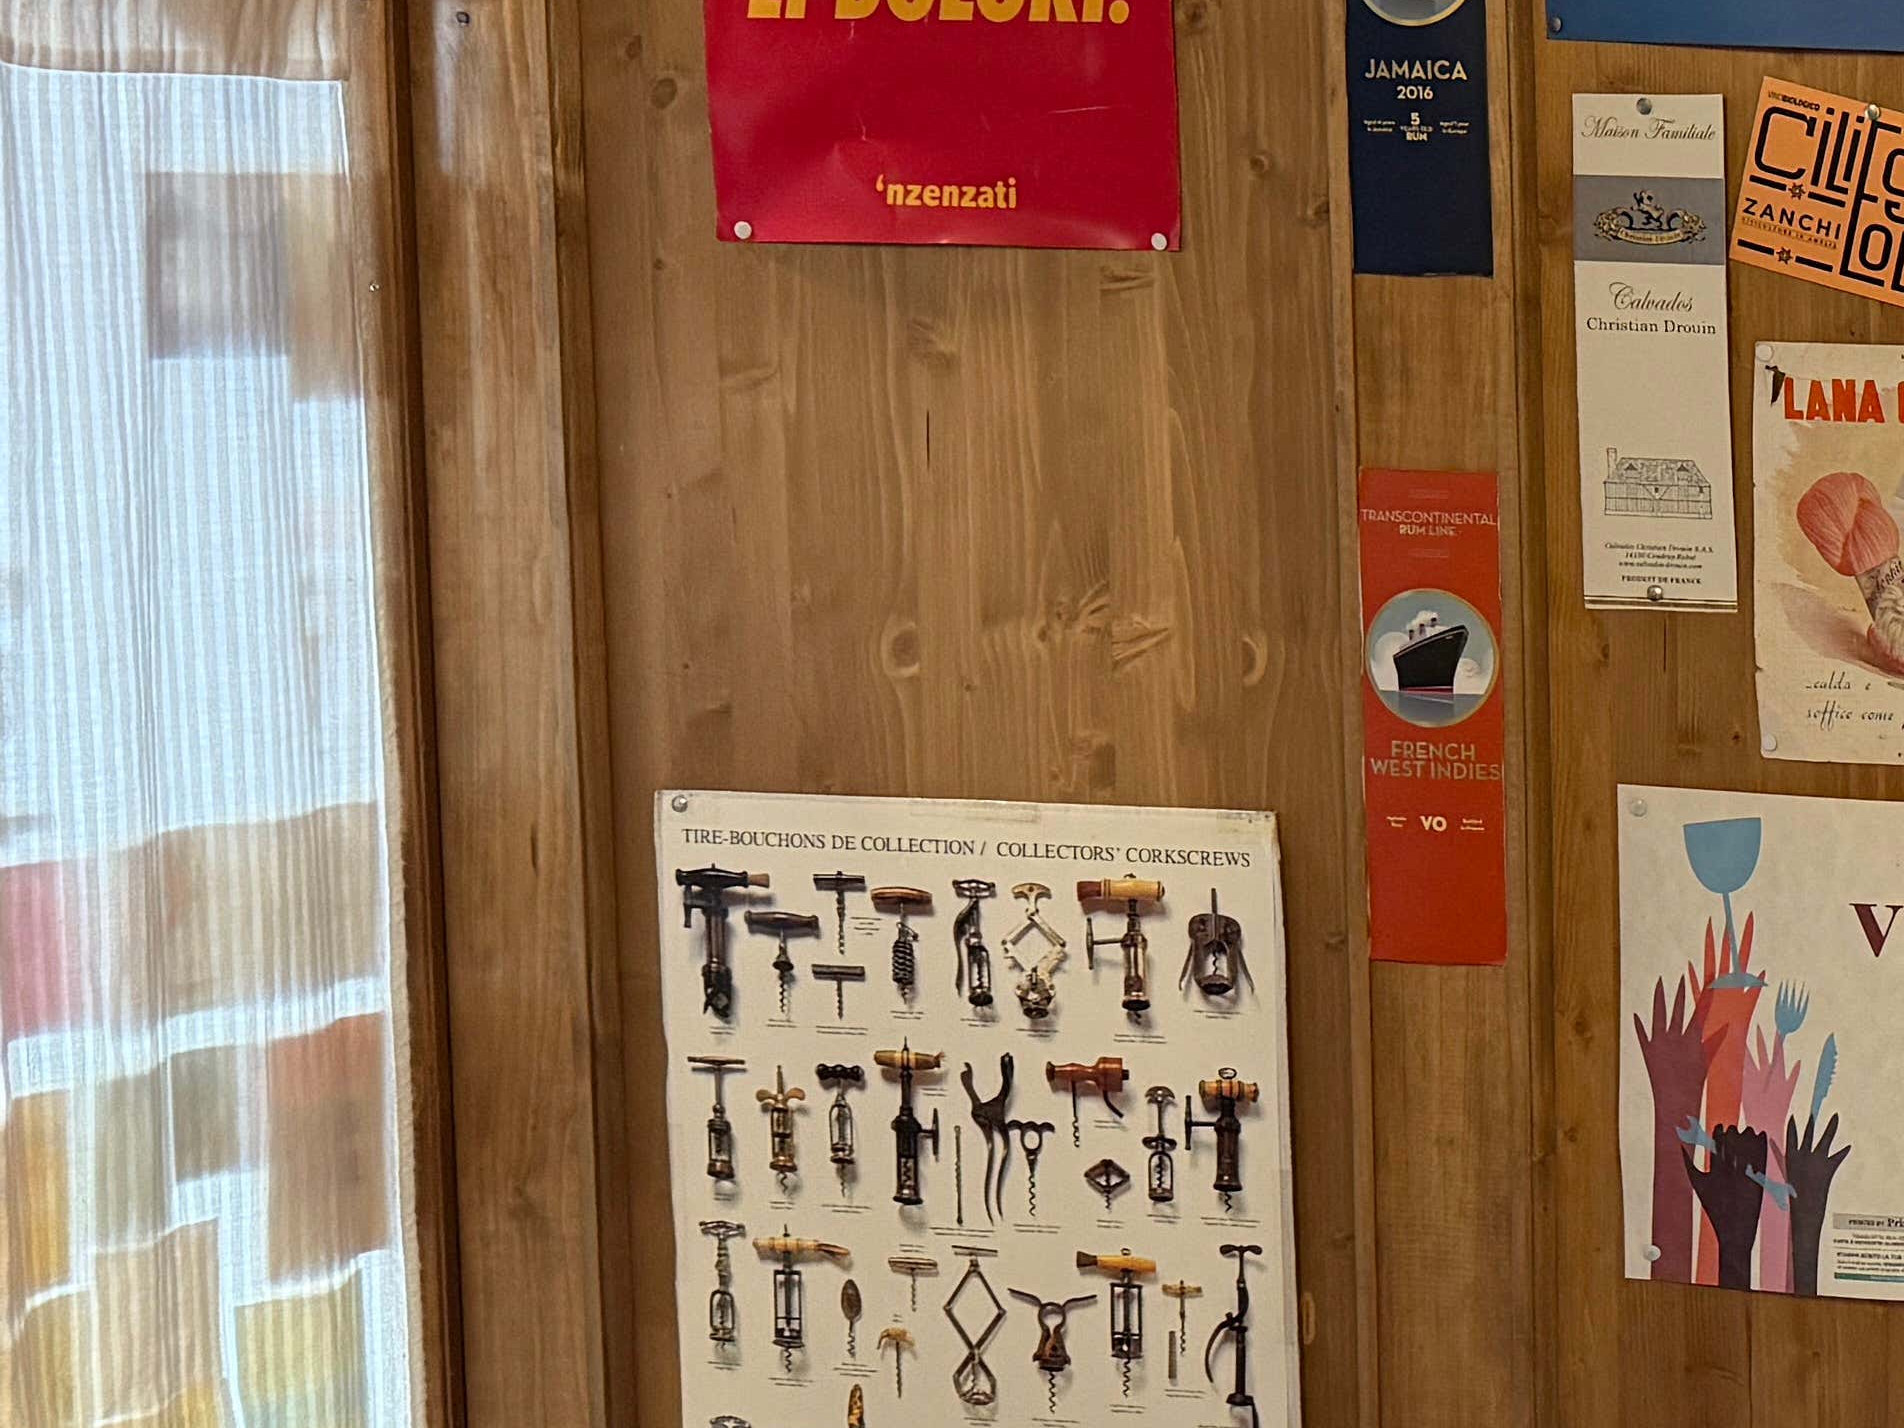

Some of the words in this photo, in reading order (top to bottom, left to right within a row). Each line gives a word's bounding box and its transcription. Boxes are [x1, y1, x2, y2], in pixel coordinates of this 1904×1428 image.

[1365, 58, 1468, 80] JAMAICA
[1396, 85, 1434, 100] 2016
[1410, 112, 1421, 125] 5
[1581, 116, 1640, 139] Maison
[1645, 118, 1716, 141] Familiale
[1742, 197, 1842, 240] ZANCHI
[1609, 282, 1693, 312] Calvados
[1586, 317, 1659, 333] Christian
[1664, 320, 1716, 335] Drouin
[1783, 378, 1884, 424] LANA
[1360, 509, 1497, 525] TRANSCONTINENTAL
[1391, 740, 1476, 761] FRENCH
[1370, 757, 1427, 778] WEST
[1430, 761, 1501, 780] INDIES
[1420, 815, 1447, 831] VO
[682, 828, 827, 852] TIRE-BOUCHONS
[831, 836, 857, 853] DE
[860, 836, 976, 856] COLLECTION
[1125, 845, 1252, 869] CORKSCREWS
